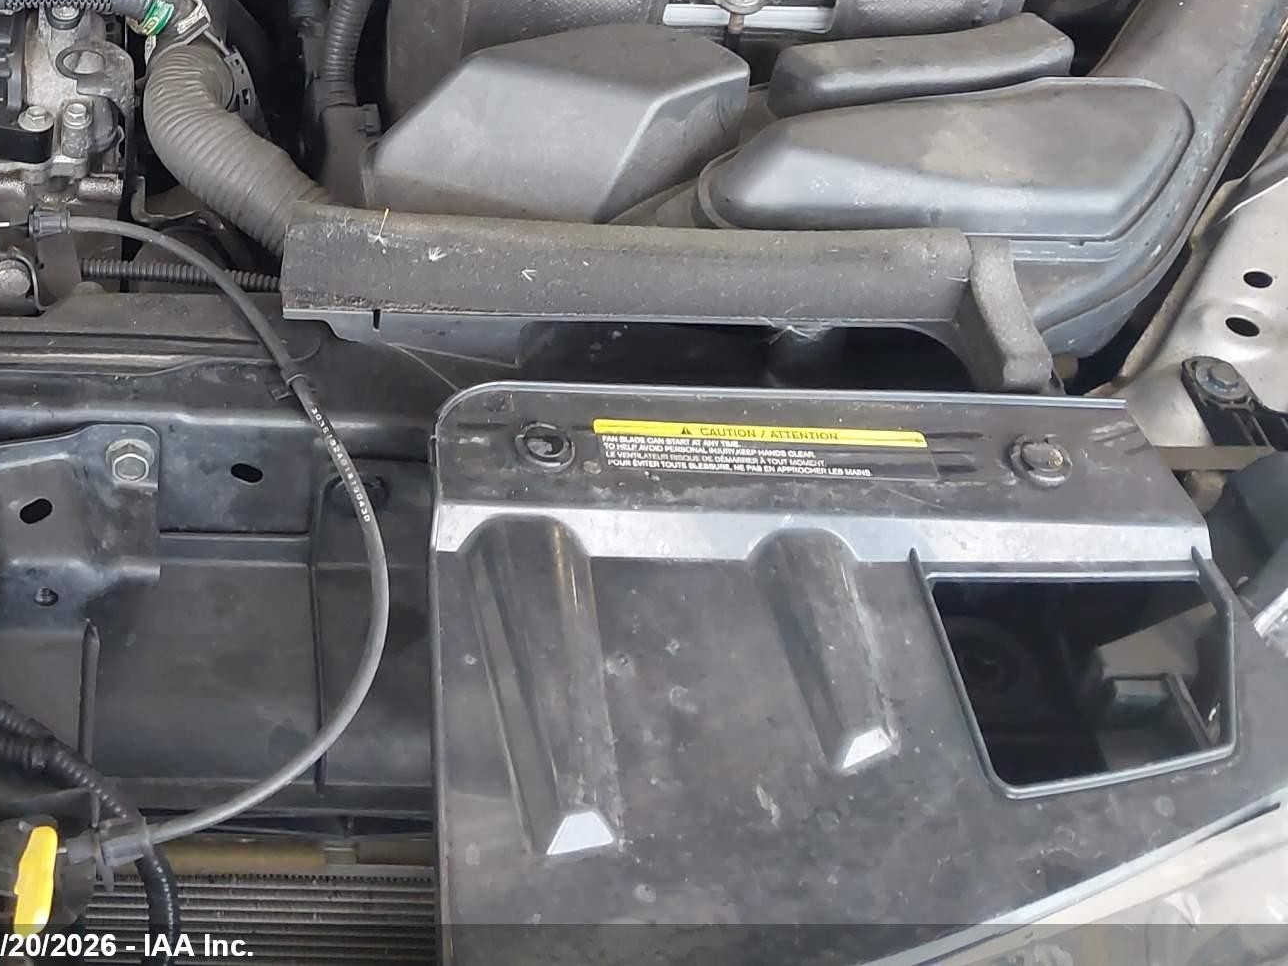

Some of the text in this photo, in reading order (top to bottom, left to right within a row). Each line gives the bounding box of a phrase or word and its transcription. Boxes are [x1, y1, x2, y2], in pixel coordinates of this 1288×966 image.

[602, 435, 618, 443] FAN
[619, 436, 645, 444] BLADE
[647, 437, 664, 445] CAN
[666, 438, 689, 446] START
[700, 427, 756, 437] CAUTION
[770, 430, 838, 441] ATTENTION
[617, 443, 637, 451] HELP
[639, 444, 663, 452] AVOID
[665, 445, 707, 454] PERSONAL
[758, 449, 787, 457] HANDS
[617, 452, 668, 461] VENTILATEUR
[670, 453, 700, 462] RISQUE
[702, 455, 713, 463] DE
[767, 457, 788, 466] TOUT
[608, 459, 631, 467] POUR
[633, 458, 660, 468] ÉVITER
[661, 460, 688, 469] TOUTE
[734, 464, 745, 472] NE
[747, 465, 762, 473] PAS
[764, 465, 776, 473] EN
[777, 466, 827, 476] APPROCHER
[828, 468, 844, 476] LES
